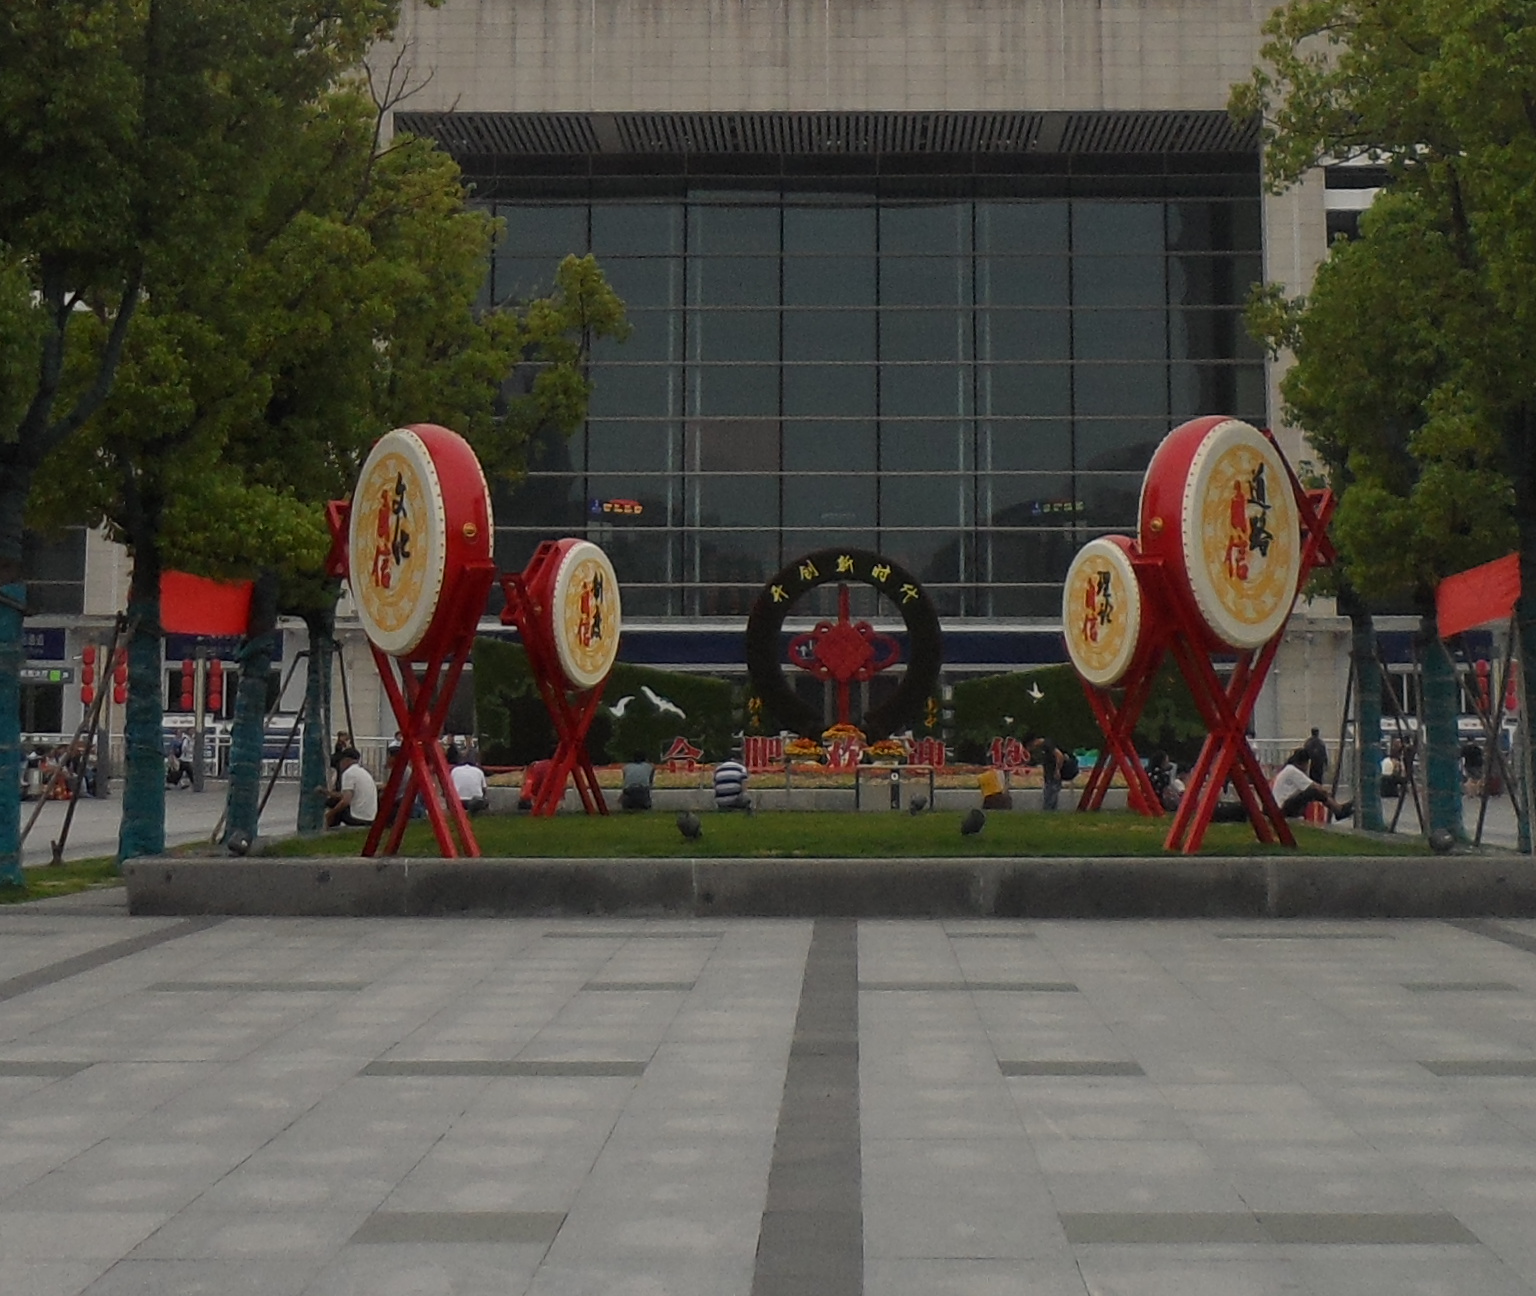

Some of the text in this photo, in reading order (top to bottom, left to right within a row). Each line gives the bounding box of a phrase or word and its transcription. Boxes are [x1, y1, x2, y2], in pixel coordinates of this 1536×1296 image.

[392, 471, 411, 566] 文化
[1224, 479, 1249, 581] 自信
[1247, 461, 1274, 557] 道路
[770, 554, 919, 604] 开创新时代
[1096, 571, 1114, 626] 理论
